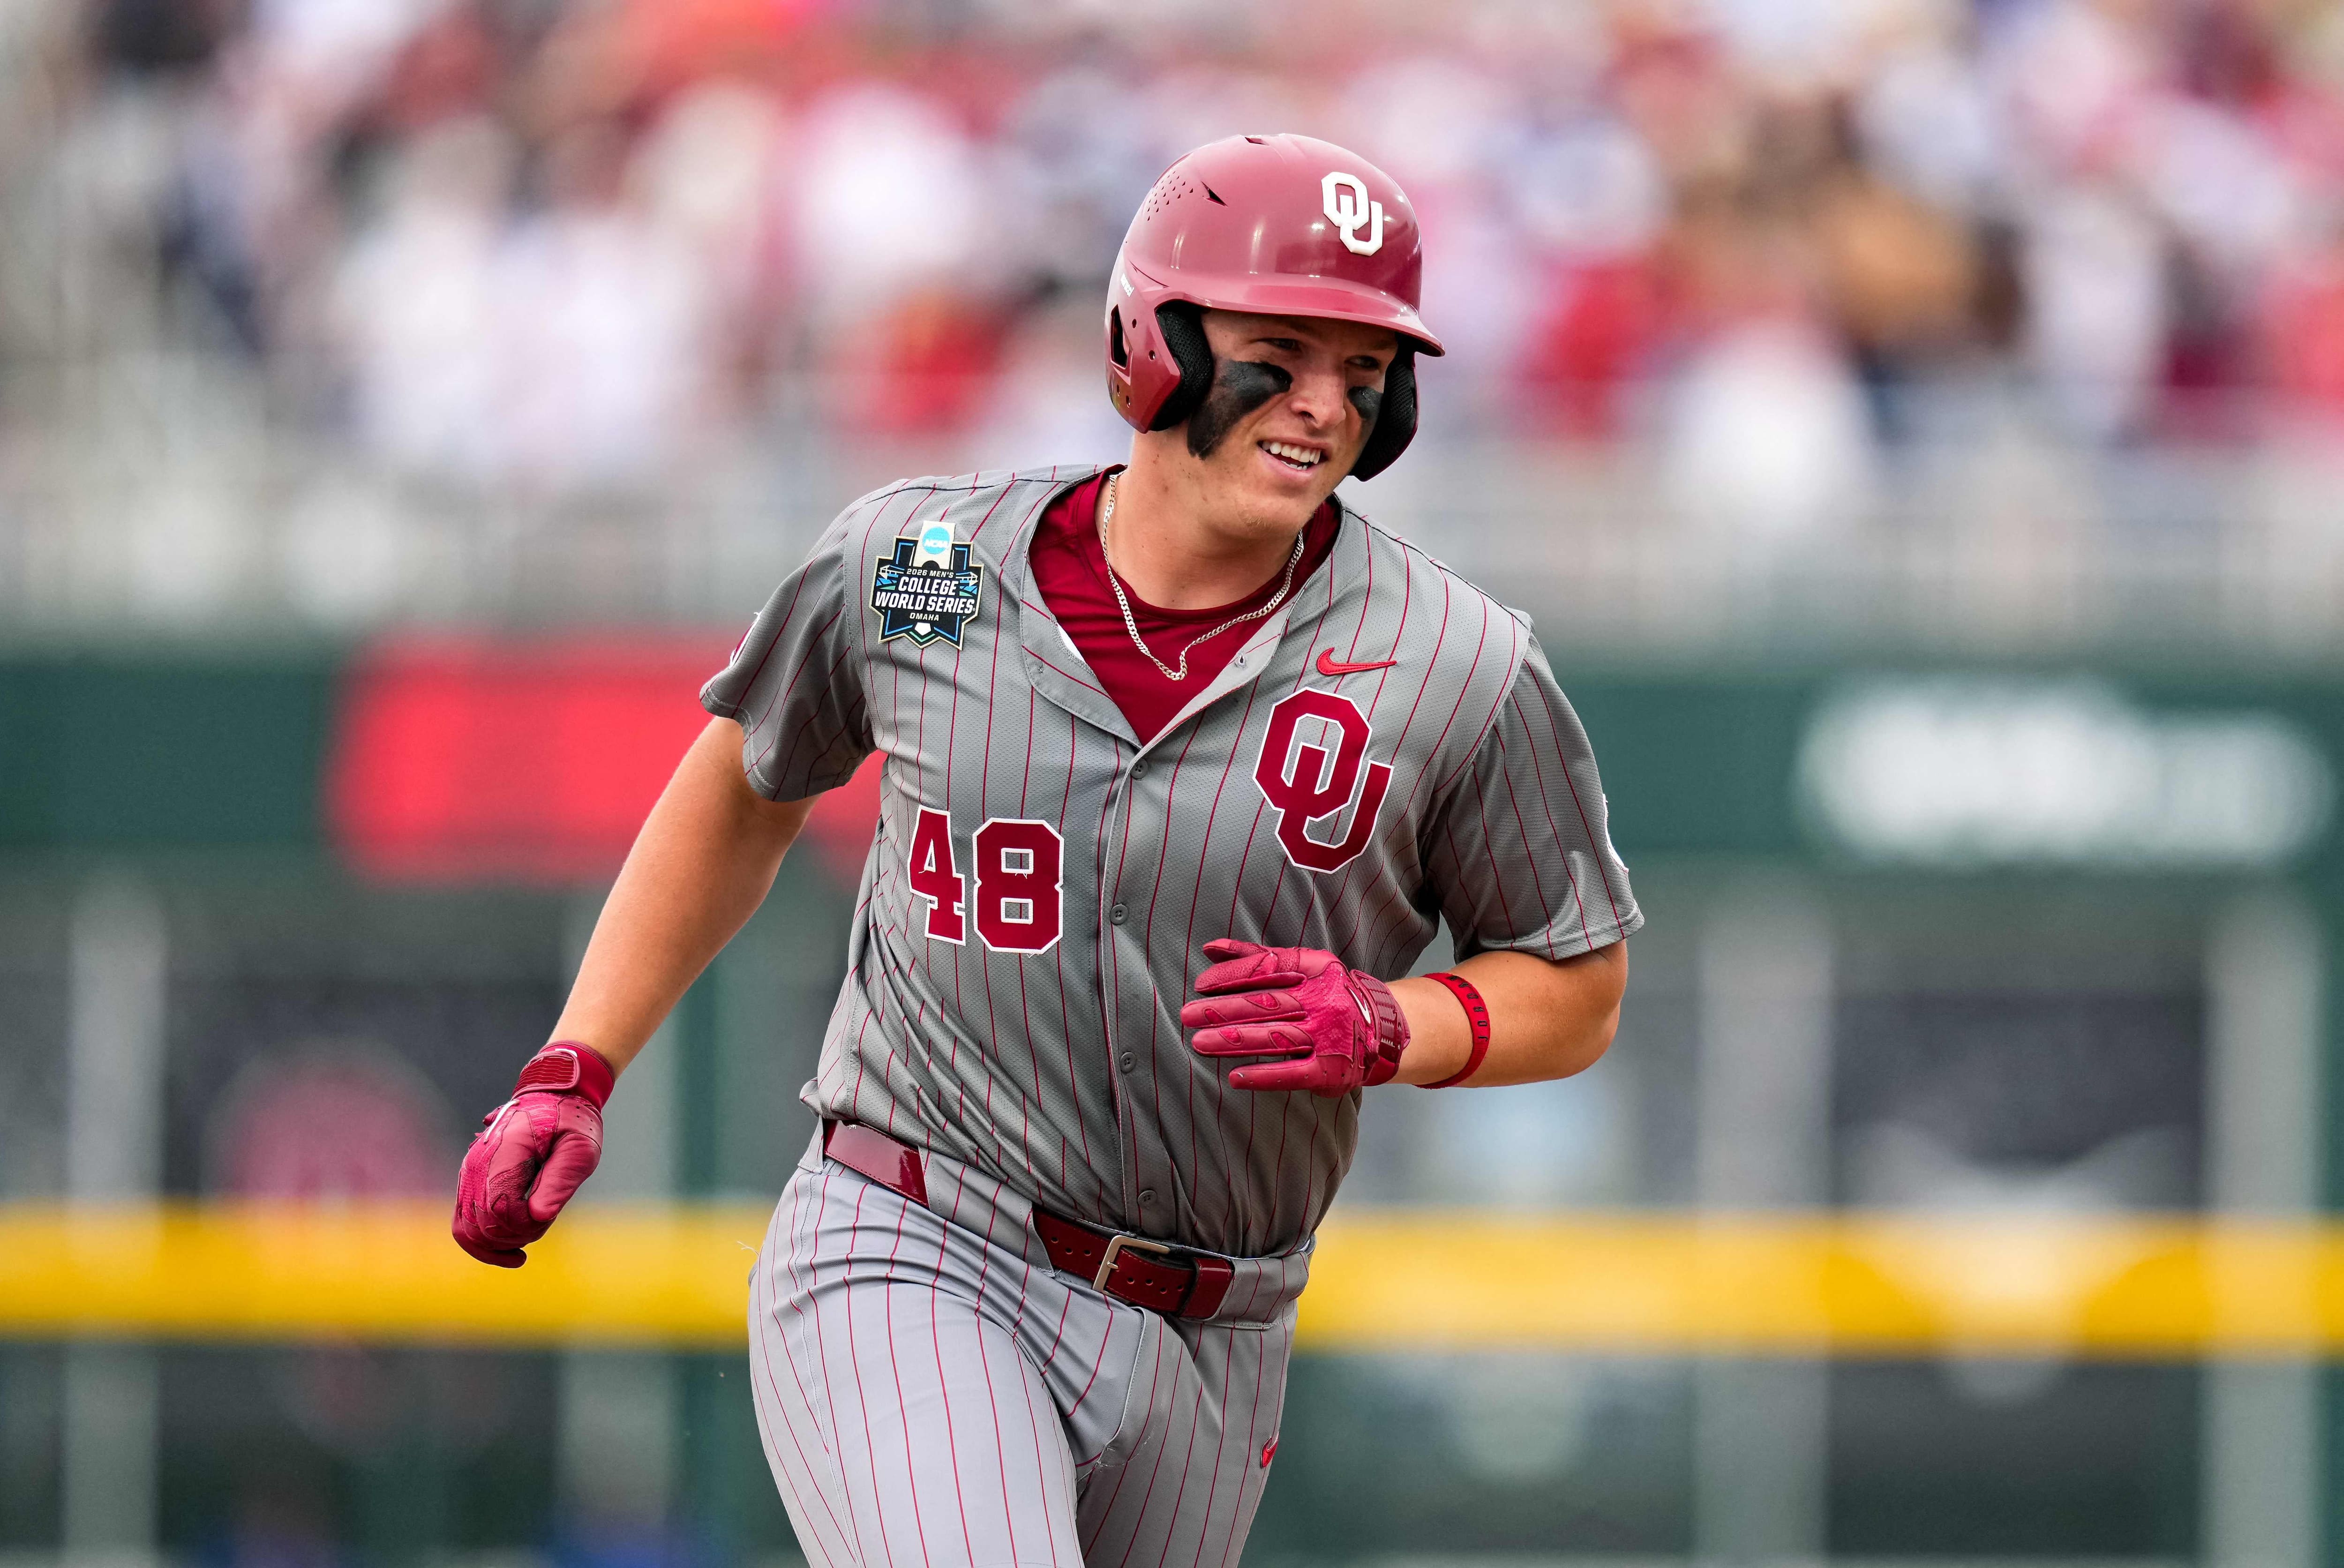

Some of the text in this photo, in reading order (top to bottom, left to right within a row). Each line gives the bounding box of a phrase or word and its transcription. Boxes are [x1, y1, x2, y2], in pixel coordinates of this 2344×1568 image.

[1321, 172, 1383, 256] OU
[924, 539, 949, 548] NCAA
[929, 570, 954, 578] MEN'S
[898, 576, 959, 595] COLLEGE
[875, 591, 925, 610] WORLD
[909, 613, 939, 621] OMAHA
[1252, 687, 1394, 874] OU
[907, 805, 1064, 954] 48
